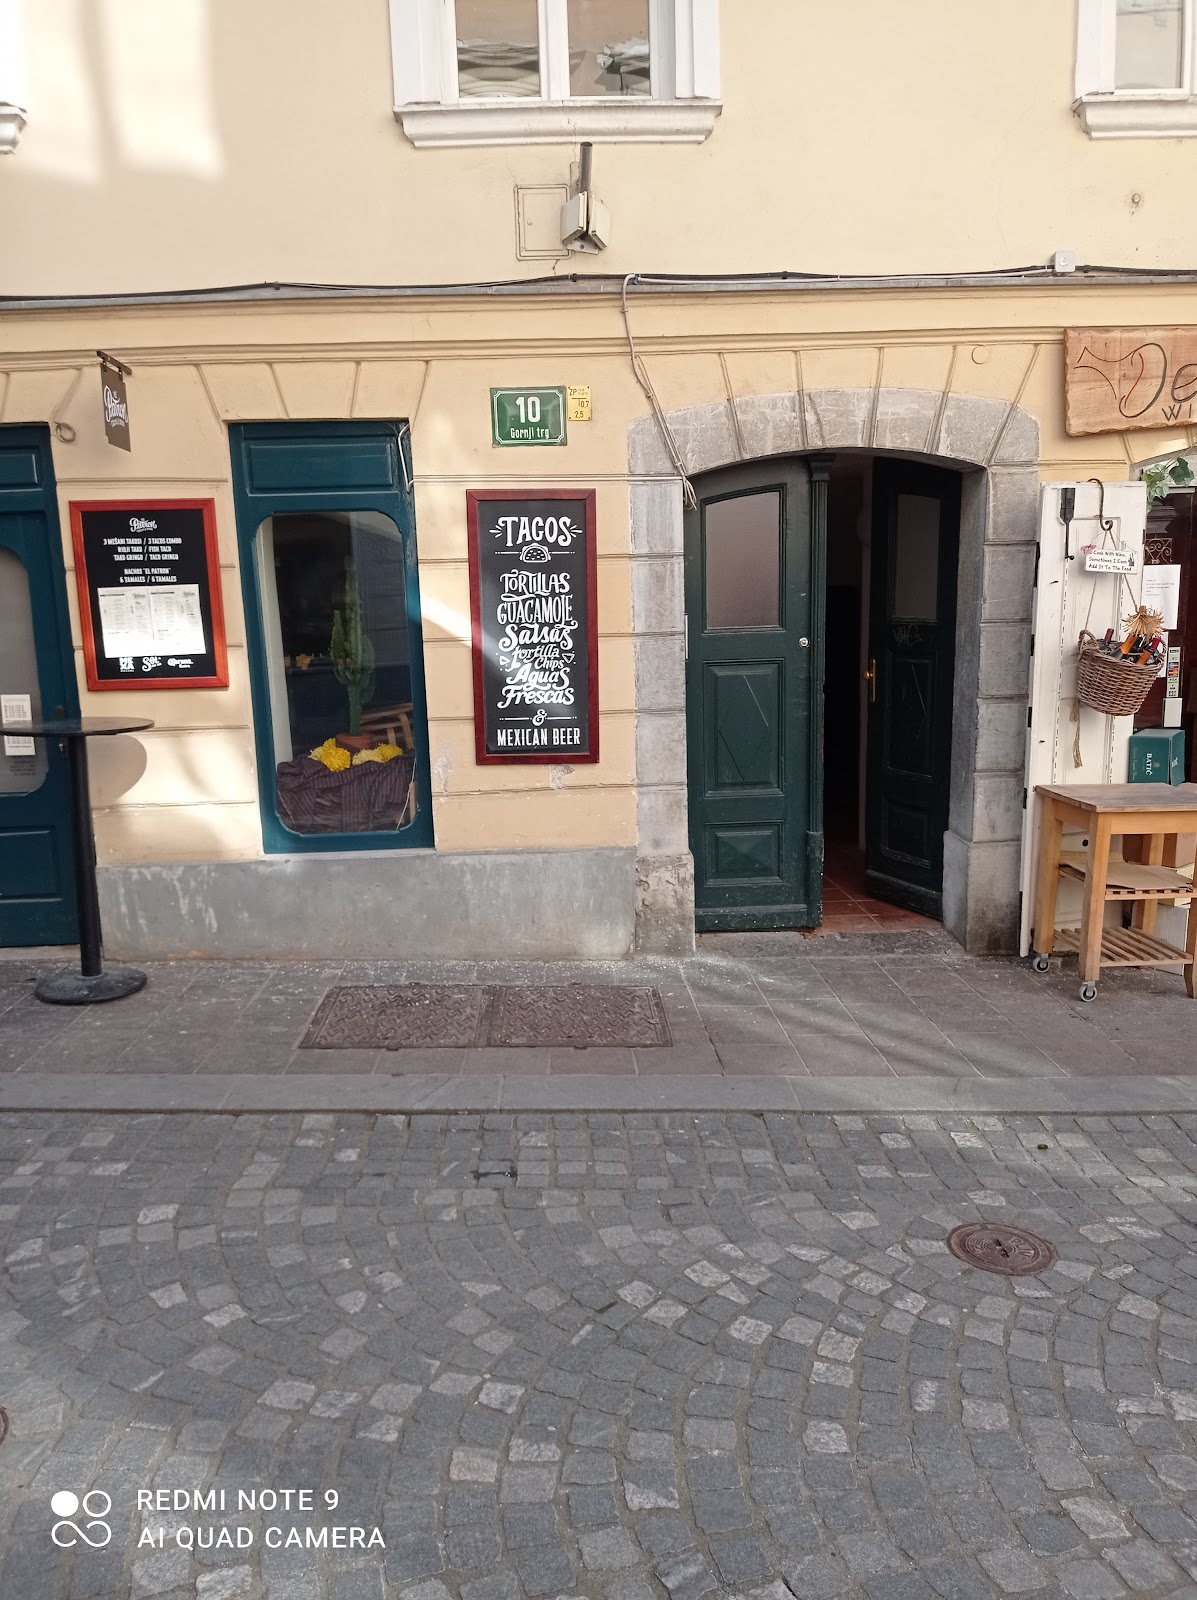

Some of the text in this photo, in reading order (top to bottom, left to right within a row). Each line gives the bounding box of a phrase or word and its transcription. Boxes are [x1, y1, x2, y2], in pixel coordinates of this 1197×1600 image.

[515, 396, 541, 424] 10
[510, 427, 550, 440] Gornji trg
[107, 536, 126, 545] MEŠANI
[147, 537, 152, 545] 3
[497, 516, 572, 547] TACOS
[499, 569, 571, 601] TORTILLAS
[496, 594, 579, 629] GUACAMOLE
[498, 623, 574, 652] Salsas
[534, 657, 565, 671] Chips
[506, 663, 571, 692] Aguas
[497, 685, 575, 709] Frescas
[532, 708, 548, 727] &
[497, 727, 581, 747] MEXICAN BEER
